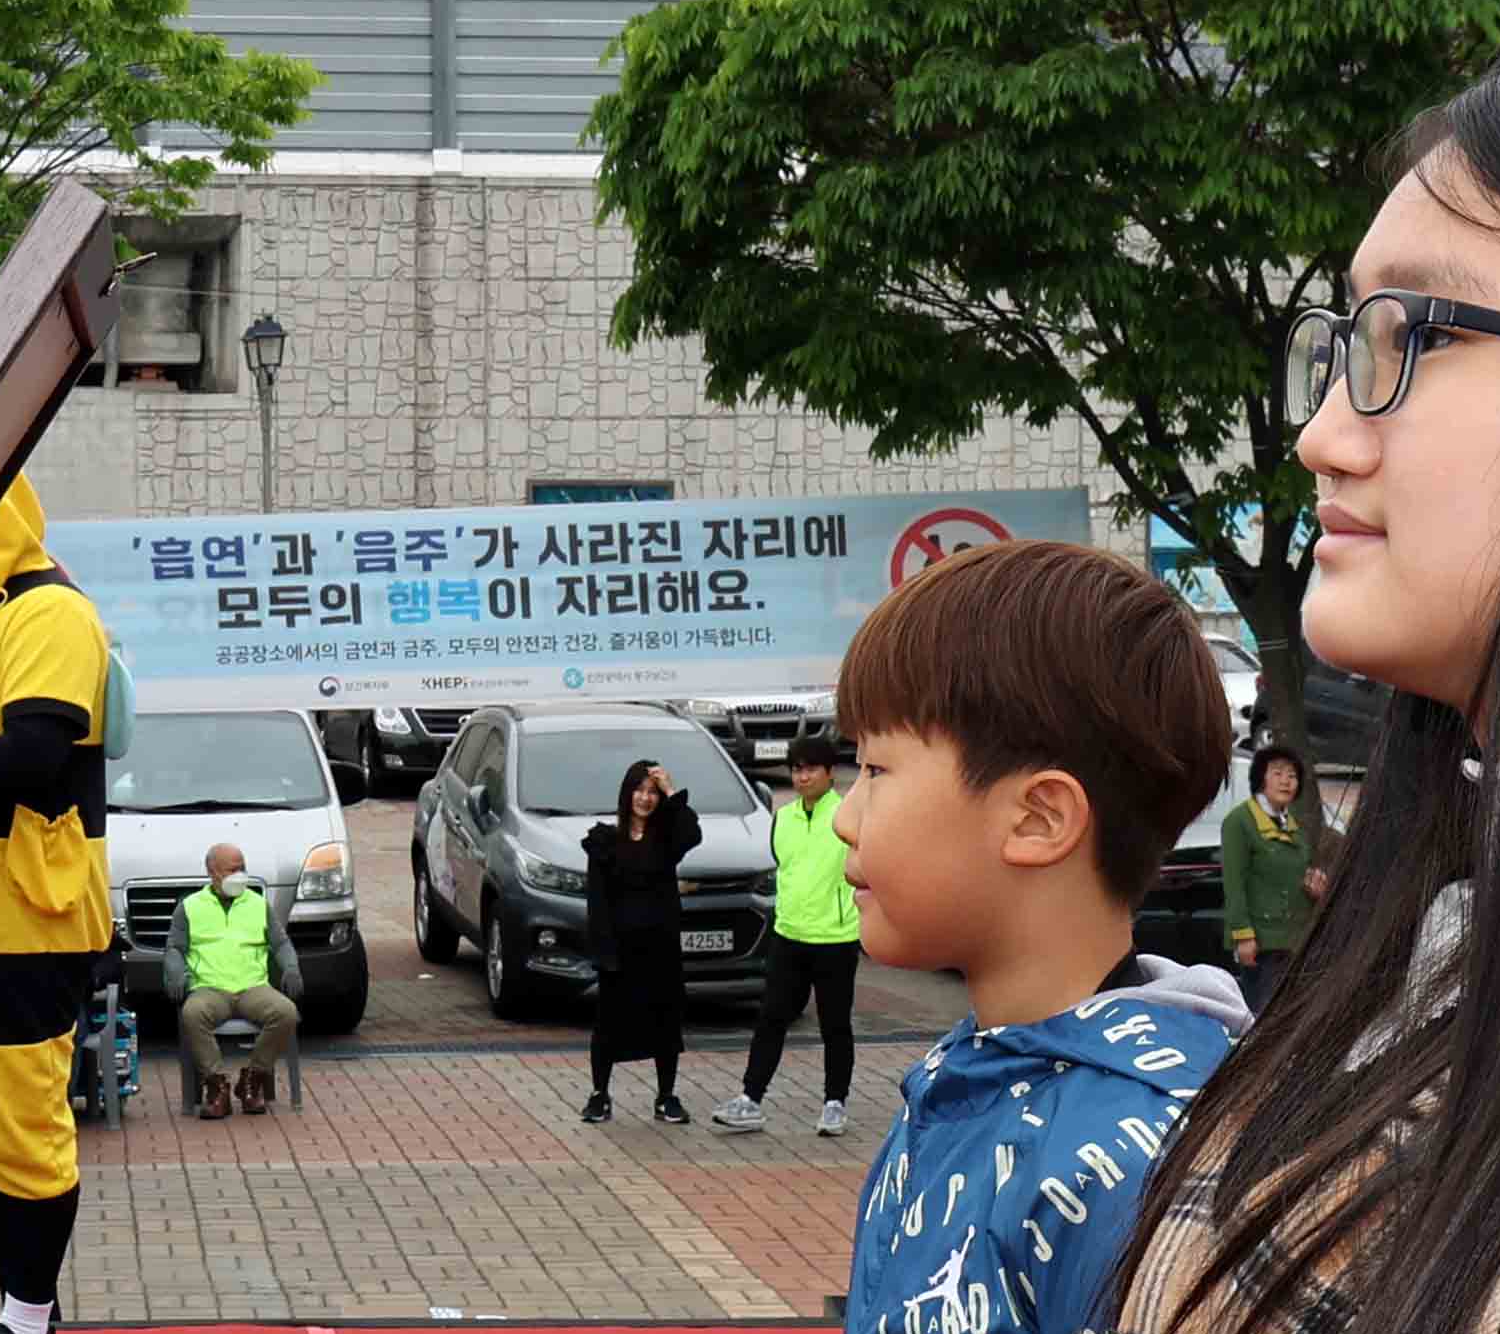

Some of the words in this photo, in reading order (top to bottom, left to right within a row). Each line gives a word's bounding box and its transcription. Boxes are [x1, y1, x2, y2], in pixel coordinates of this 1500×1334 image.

[537, 519, 684, 566] 사라진
[702, 514, 848, 560] 자리에
[216, 582, 364, 629] 모두의
[386, 576, 533, 625] 행복이
[555, 568, 766, 618] 자리해요.
[215, 642, 339, 665] 공공장소에서의
[343, 640, 397, 661] 금연과
[447, 636, 500, 656] 모두의
[505, 632, 557, 655] 안전과
[608, 629, 680, 652] 즐거움이
[684, 625, 777, 649] 가득합니다.
